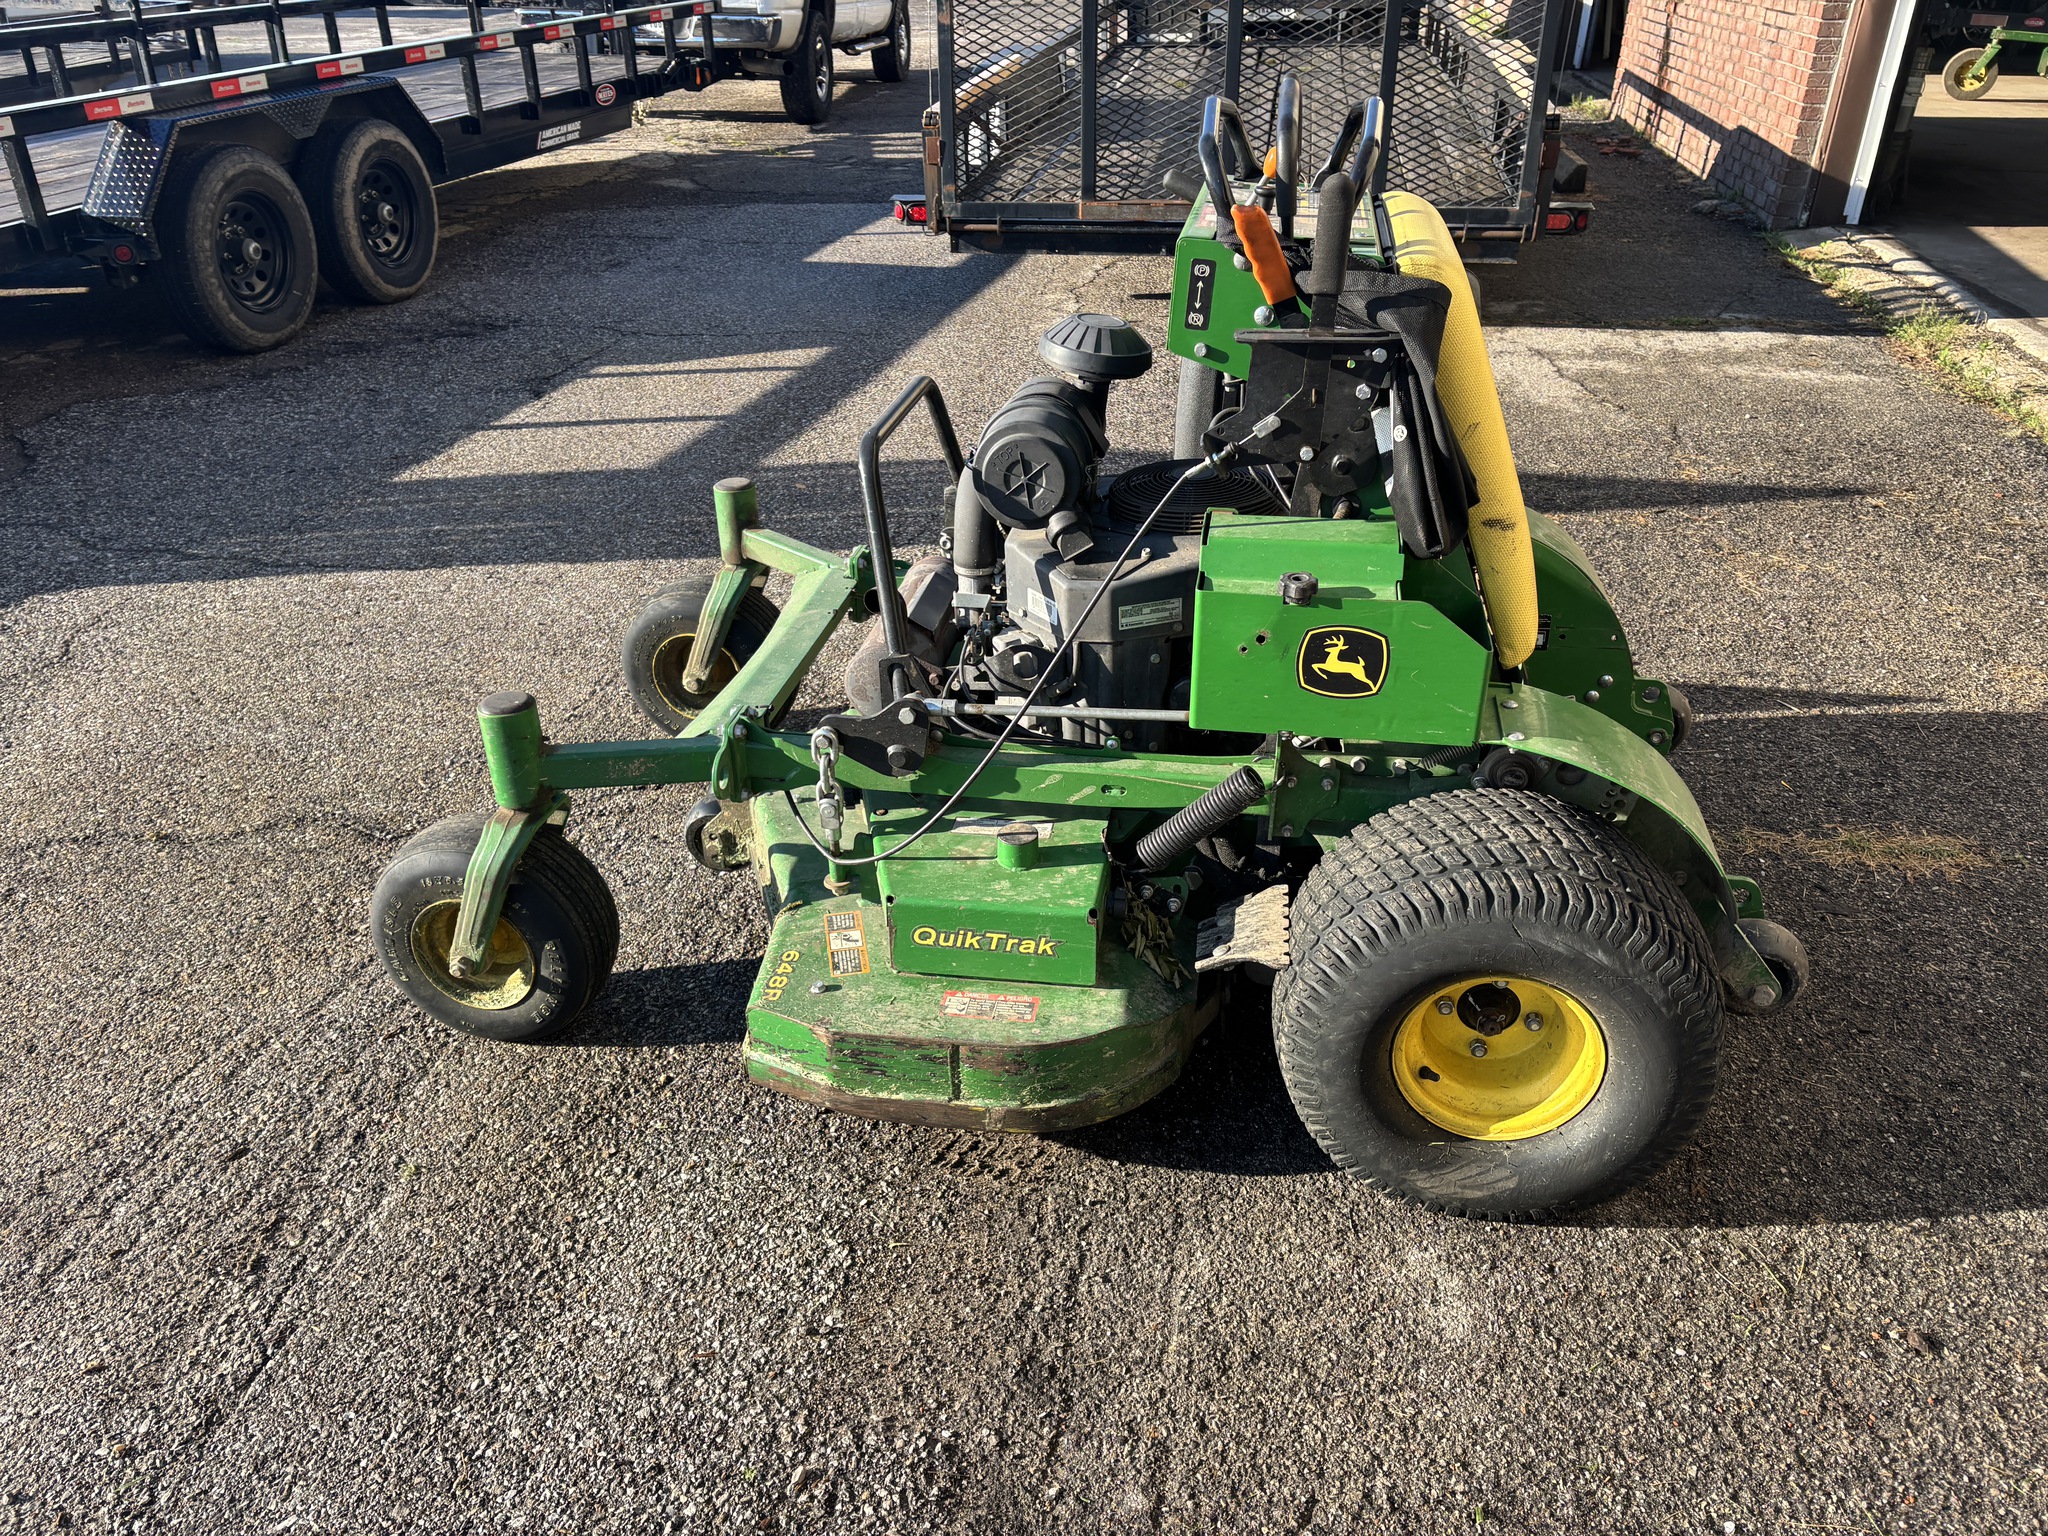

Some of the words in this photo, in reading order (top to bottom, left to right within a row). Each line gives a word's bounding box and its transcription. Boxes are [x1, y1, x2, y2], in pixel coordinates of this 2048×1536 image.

[994, 446, 1014, 465] TOP
[913, 926, 1056, 956] QuikTrak
[763, 950, 800, 1001] 648R
